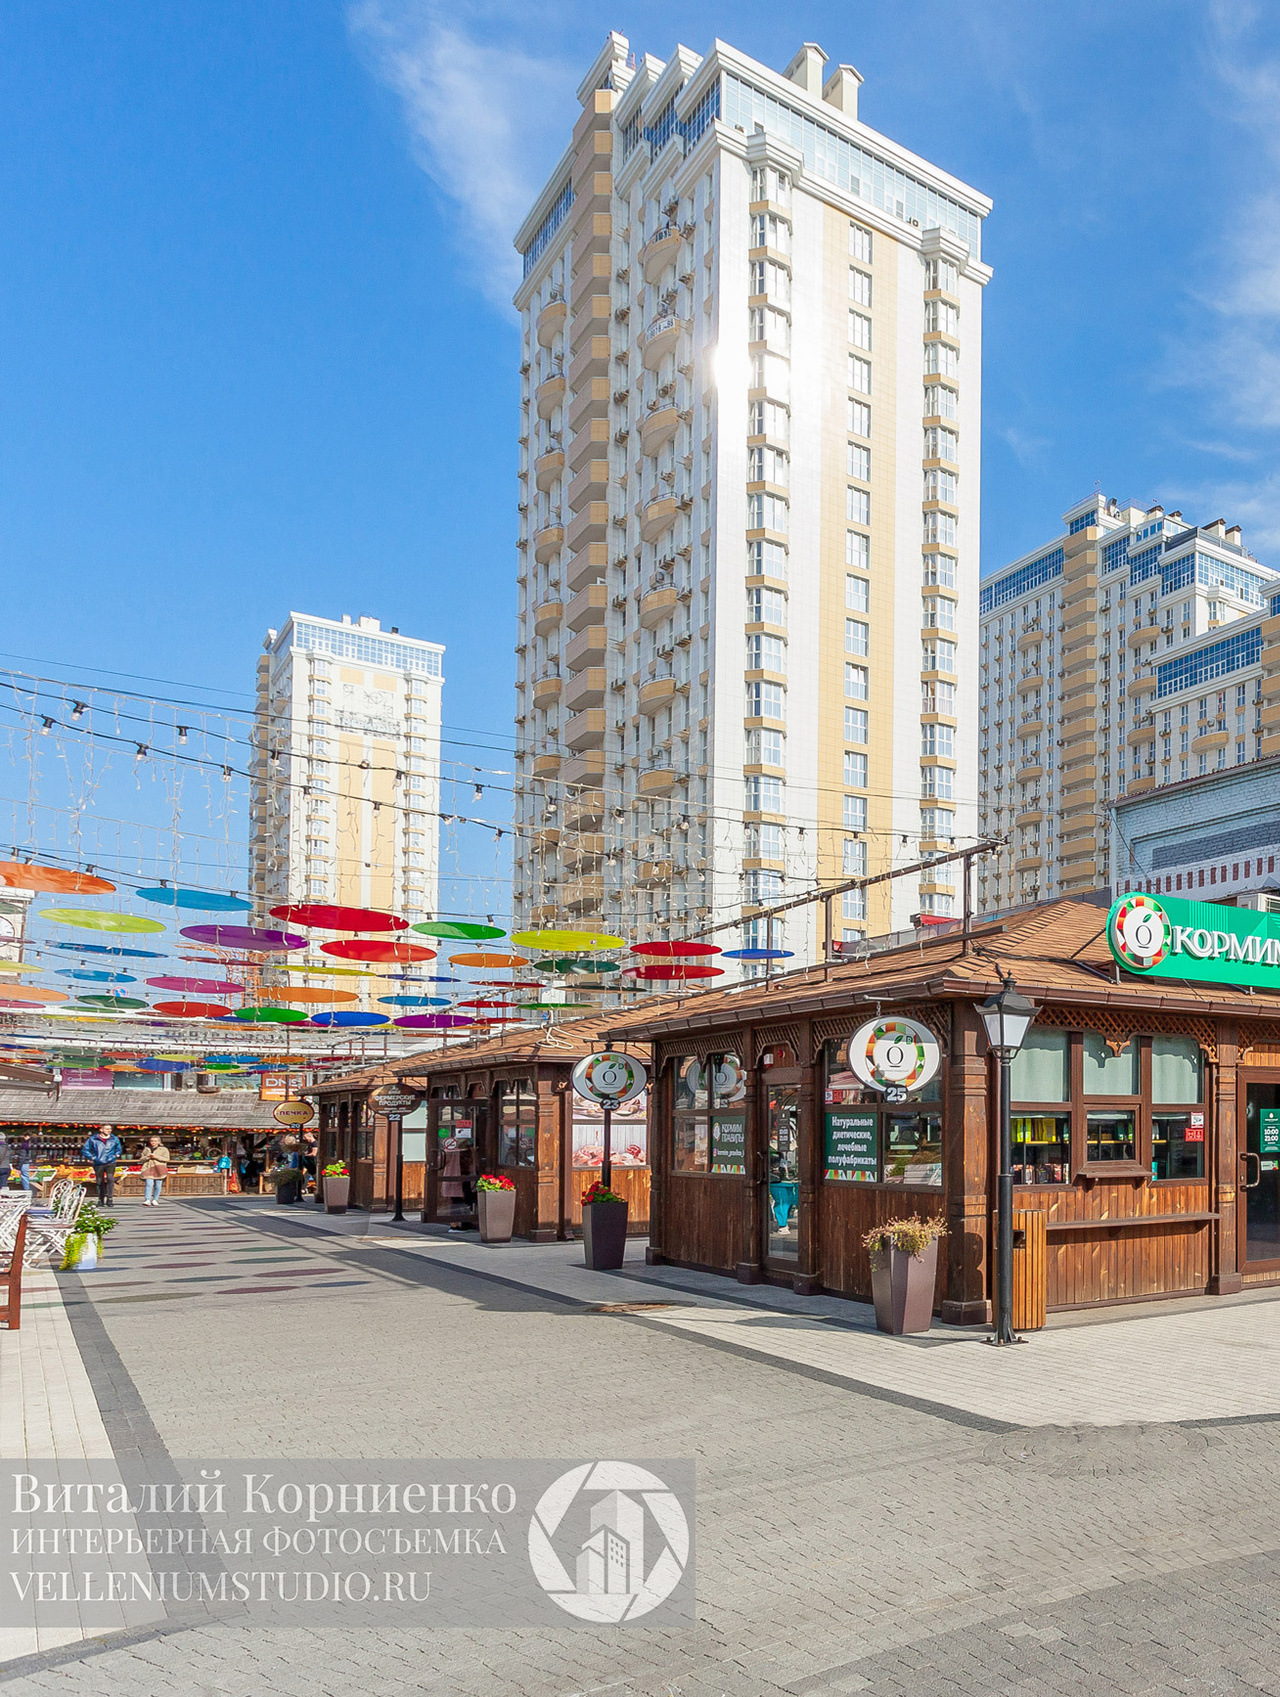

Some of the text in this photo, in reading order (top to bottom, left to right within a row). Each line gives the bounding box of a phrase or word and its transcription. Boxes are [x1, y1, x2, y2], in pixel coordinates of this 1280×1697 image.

[887, 1087, 907, 1102] 25
[602, 1101, 620, 1110] 23
[831, 1116, 874, 1129] Натуральные
[832, 1131, 873, 1140] диетические,
[837, 1142, 867, 1152] лечебные
[828, 1153, 877, 1166] полуфабрикаты
